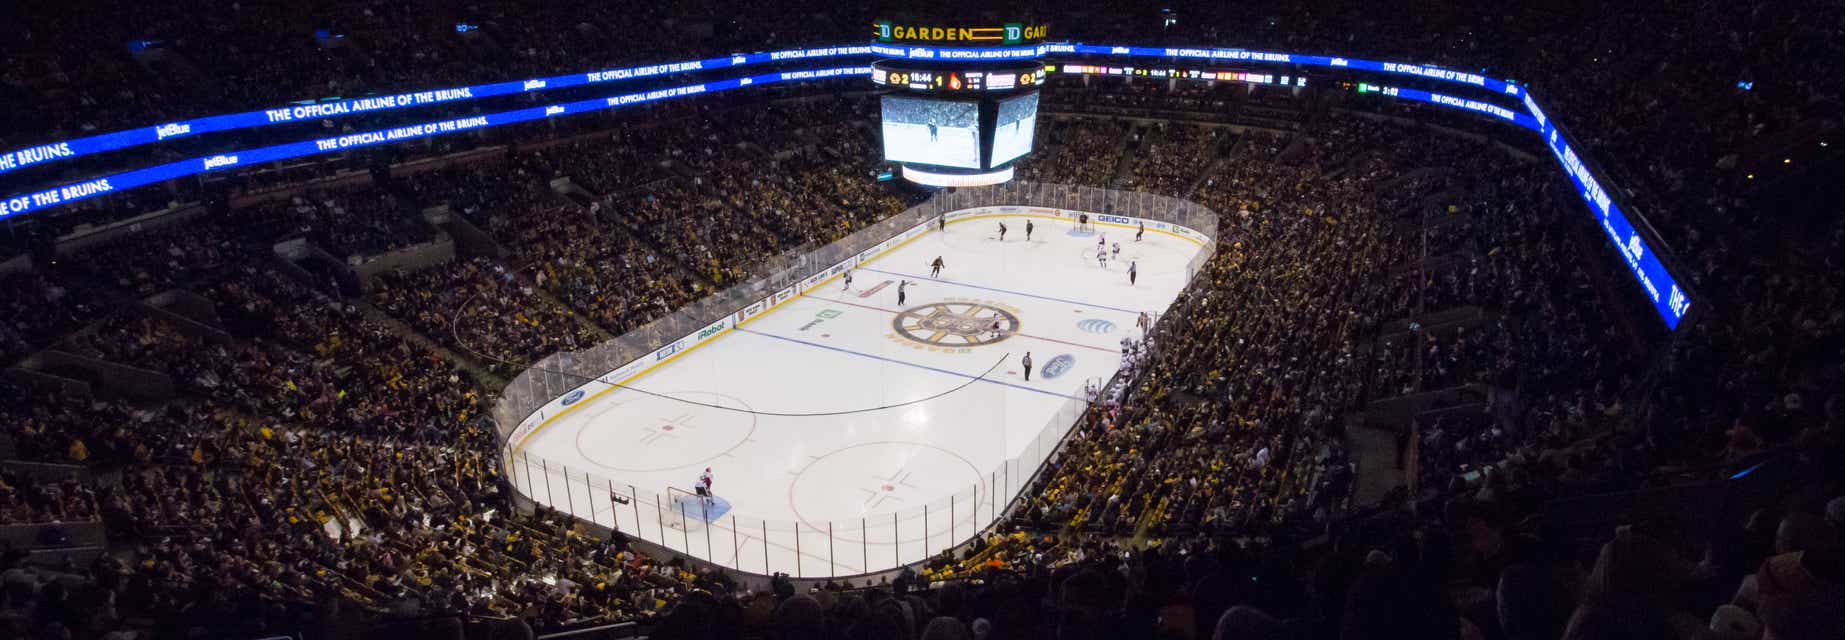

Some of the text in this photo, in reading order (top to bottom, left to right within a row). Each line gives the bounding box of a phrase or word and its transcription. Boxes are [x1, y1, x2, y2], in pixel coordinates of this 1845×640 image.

[894, 26, 973, 41] GARDEN
[1211, 51, 1239, 59] AIRLINE
[588, 71, 602, 83] THE
[602, 69, 633, 80] OFFICIAL
[634, 66, 659, 76] AIRLINE
[660, 65, 669, 73] OF
[670, 63, 680, 72] THE
[1384, 62, 1396, 71] THE
[901, 74, 909, 85] 2
[936, 75, 943, 87] 1
[621, 93, 646, 104] OFFICIAL
[670, 89, 679, 97] OF
[266, 87, 473, 123] THE OFFICIAL AIRLINE OF THE BRUINS.
[156, 123, 190, 140] jetBlue
[316, 115, 489, 151] THE OFFICIAL AIRLINE OF THE BRUINS.
[17, 142, 75, 167] BRUINS.
[204, 155, 238, 170] jetBlue
[10, 197, 31, 211] OF
[32, 190, 60, 207] THE
[62, 178, 113, 200] BRUINS.
[1098, 215, 1129, 225] GEICO
[697, 321, 725, 341] iRobot
